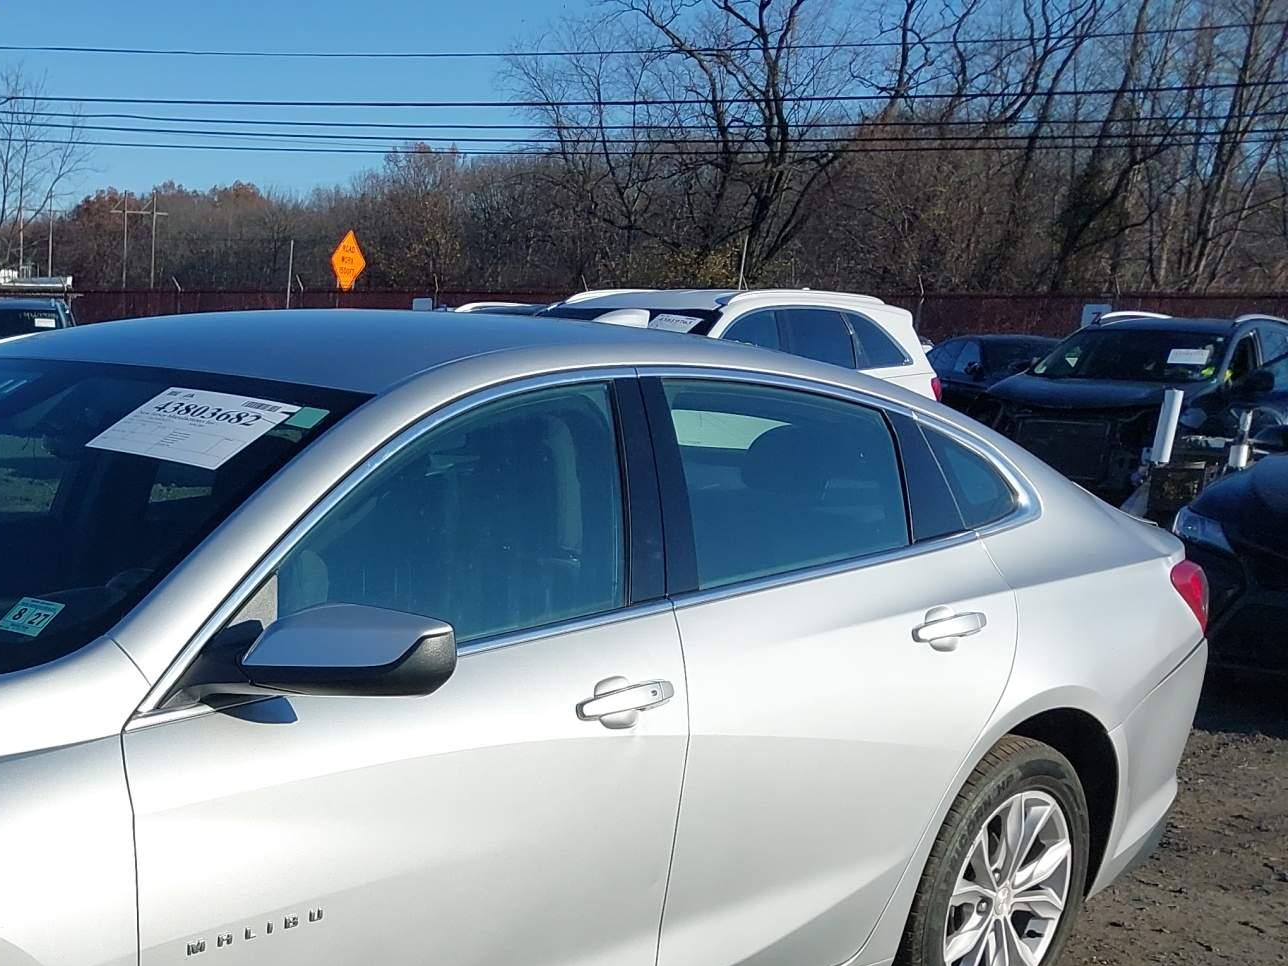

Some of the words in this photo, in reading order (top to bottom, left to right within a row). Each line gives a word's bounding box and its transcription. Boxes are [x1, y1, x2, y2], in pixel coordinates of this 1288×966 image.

[153, 400, 262, 427] 43803682
[12, 607, 28, 621] 8
[28, 612, 51, 626] 27
[186, 906, 325, 956] MALIBU
